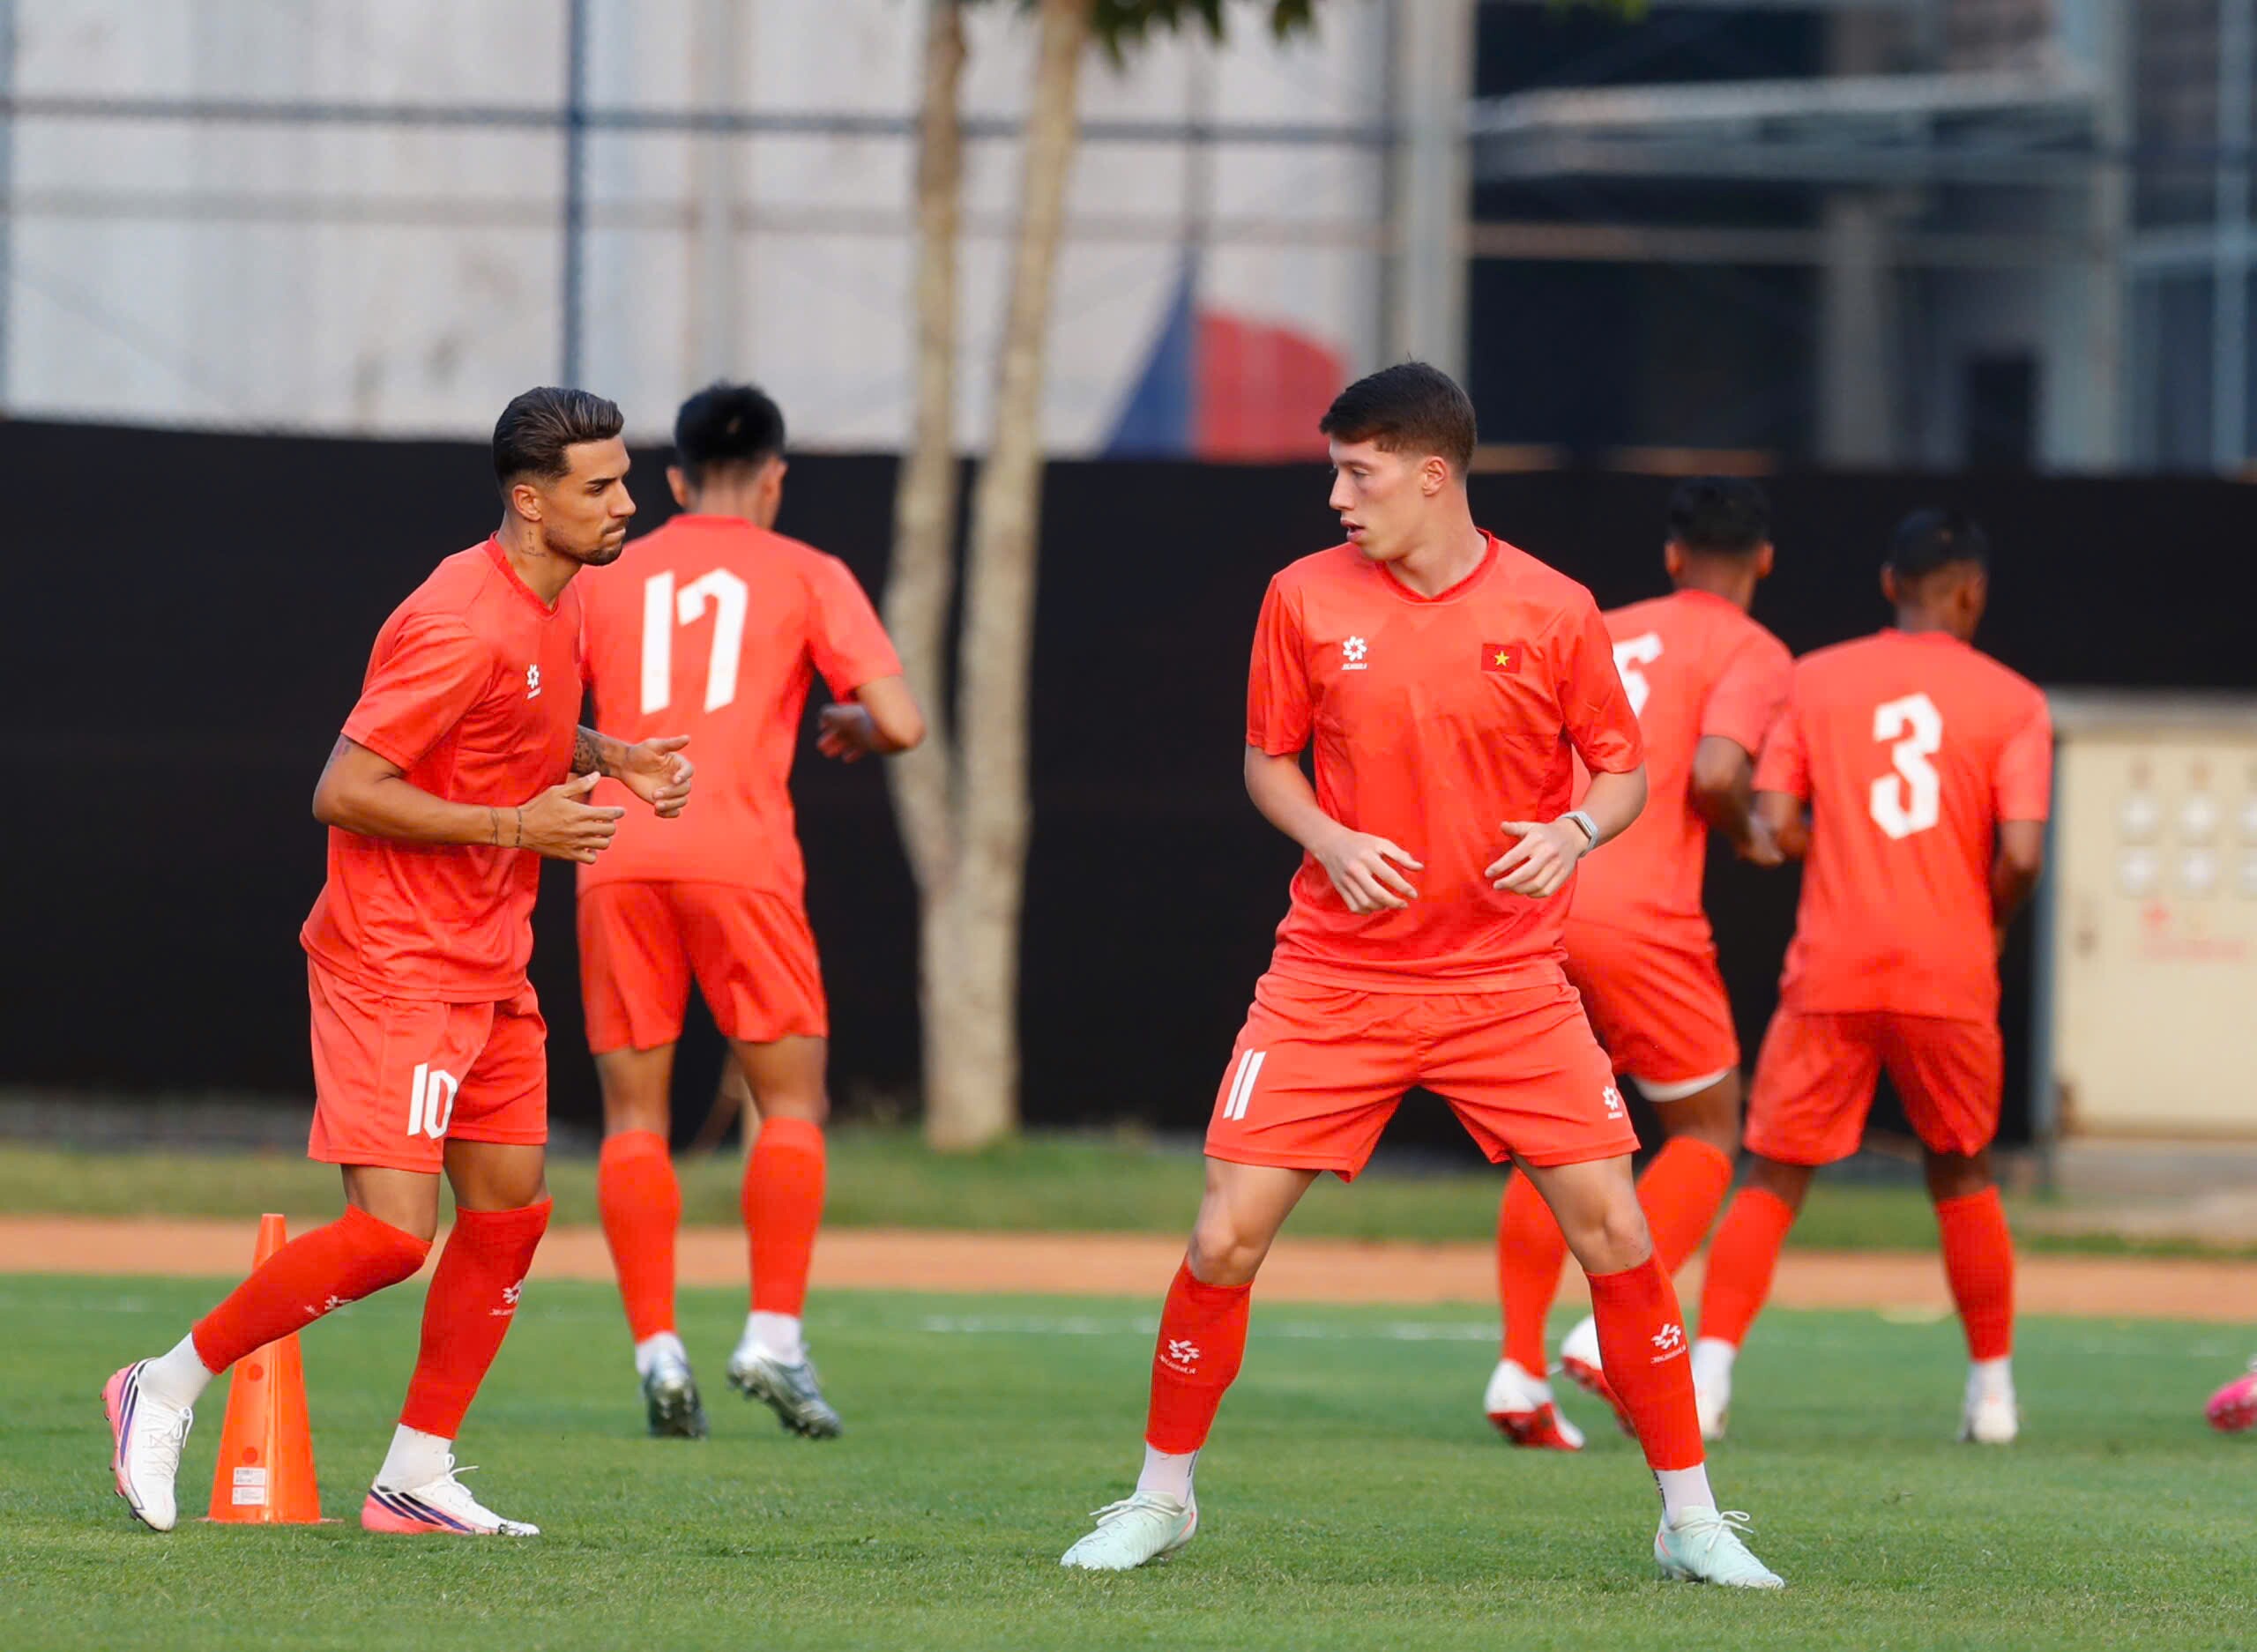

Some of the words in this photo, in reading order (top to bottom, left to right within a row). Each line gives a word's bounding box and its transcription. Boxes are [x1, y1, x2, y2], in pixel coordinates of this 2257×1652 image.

[641, 569, 749, 715] 17
[1871, 693, 1943, 839] 3
[407, 1062, 458, 1139] 10
[1222, 1048, 1267, 1121] 11
